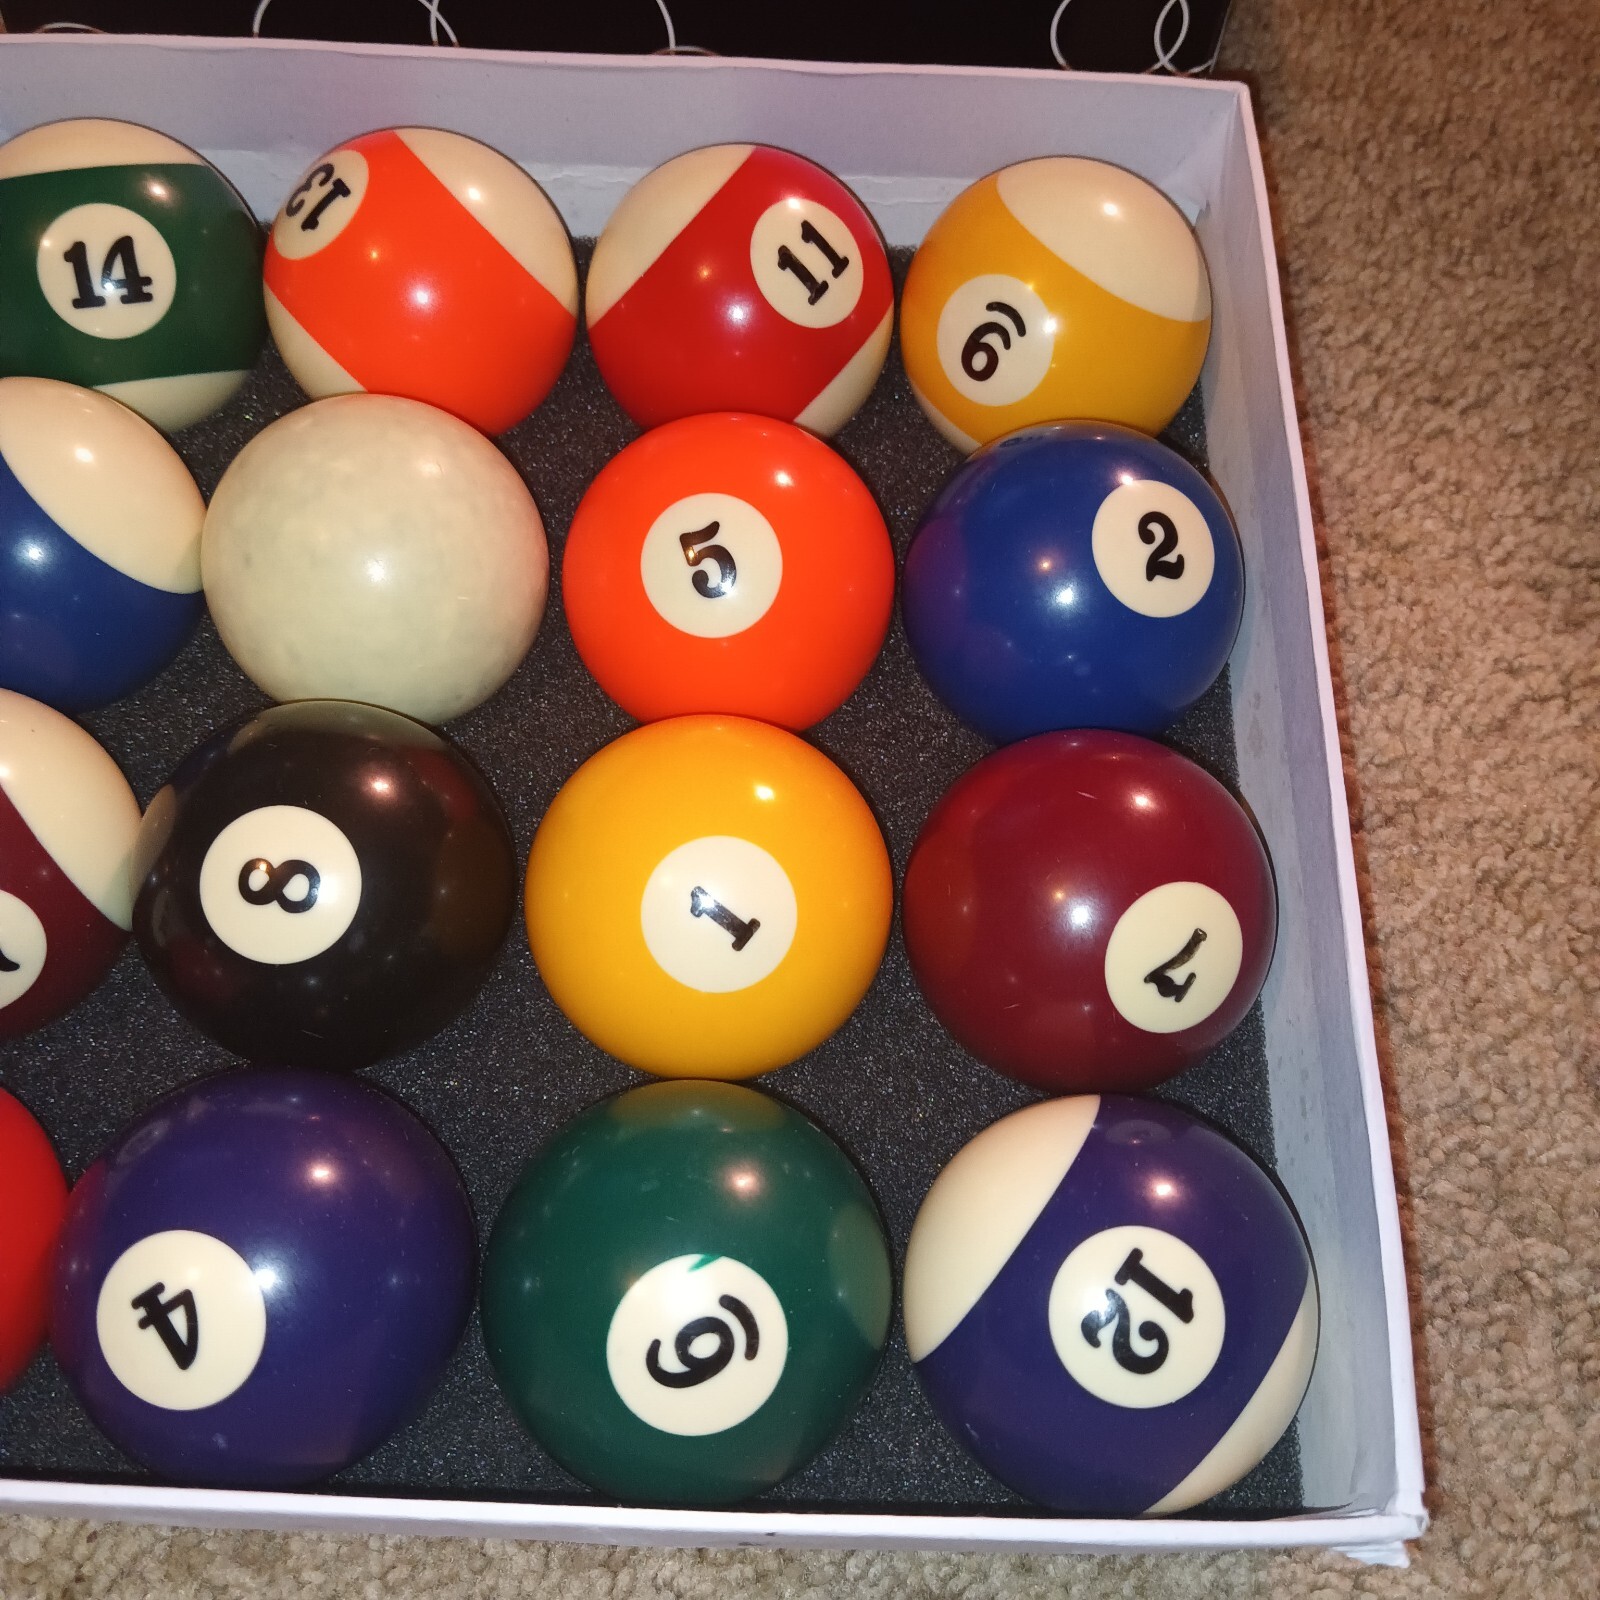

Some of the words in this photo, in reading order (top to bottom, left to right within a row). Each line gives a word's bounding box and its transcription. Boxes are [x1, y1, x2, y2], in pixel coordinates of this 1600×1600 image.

[285, 162, 352, 232] 13
[63, 235, 154, 310] 14
[777, 219, 850, 306] 11
[680, 520, 737, 599] 5
[1137, 510, 1185, 582] 2
[237, 857, 321, 914] 8
[690, 885, 761, 952] 1
[1143, 927, 1208, 1003] 7
[130, 1282, 199, 1371] 4
[1080, 1247, 1195, 1375] 12
